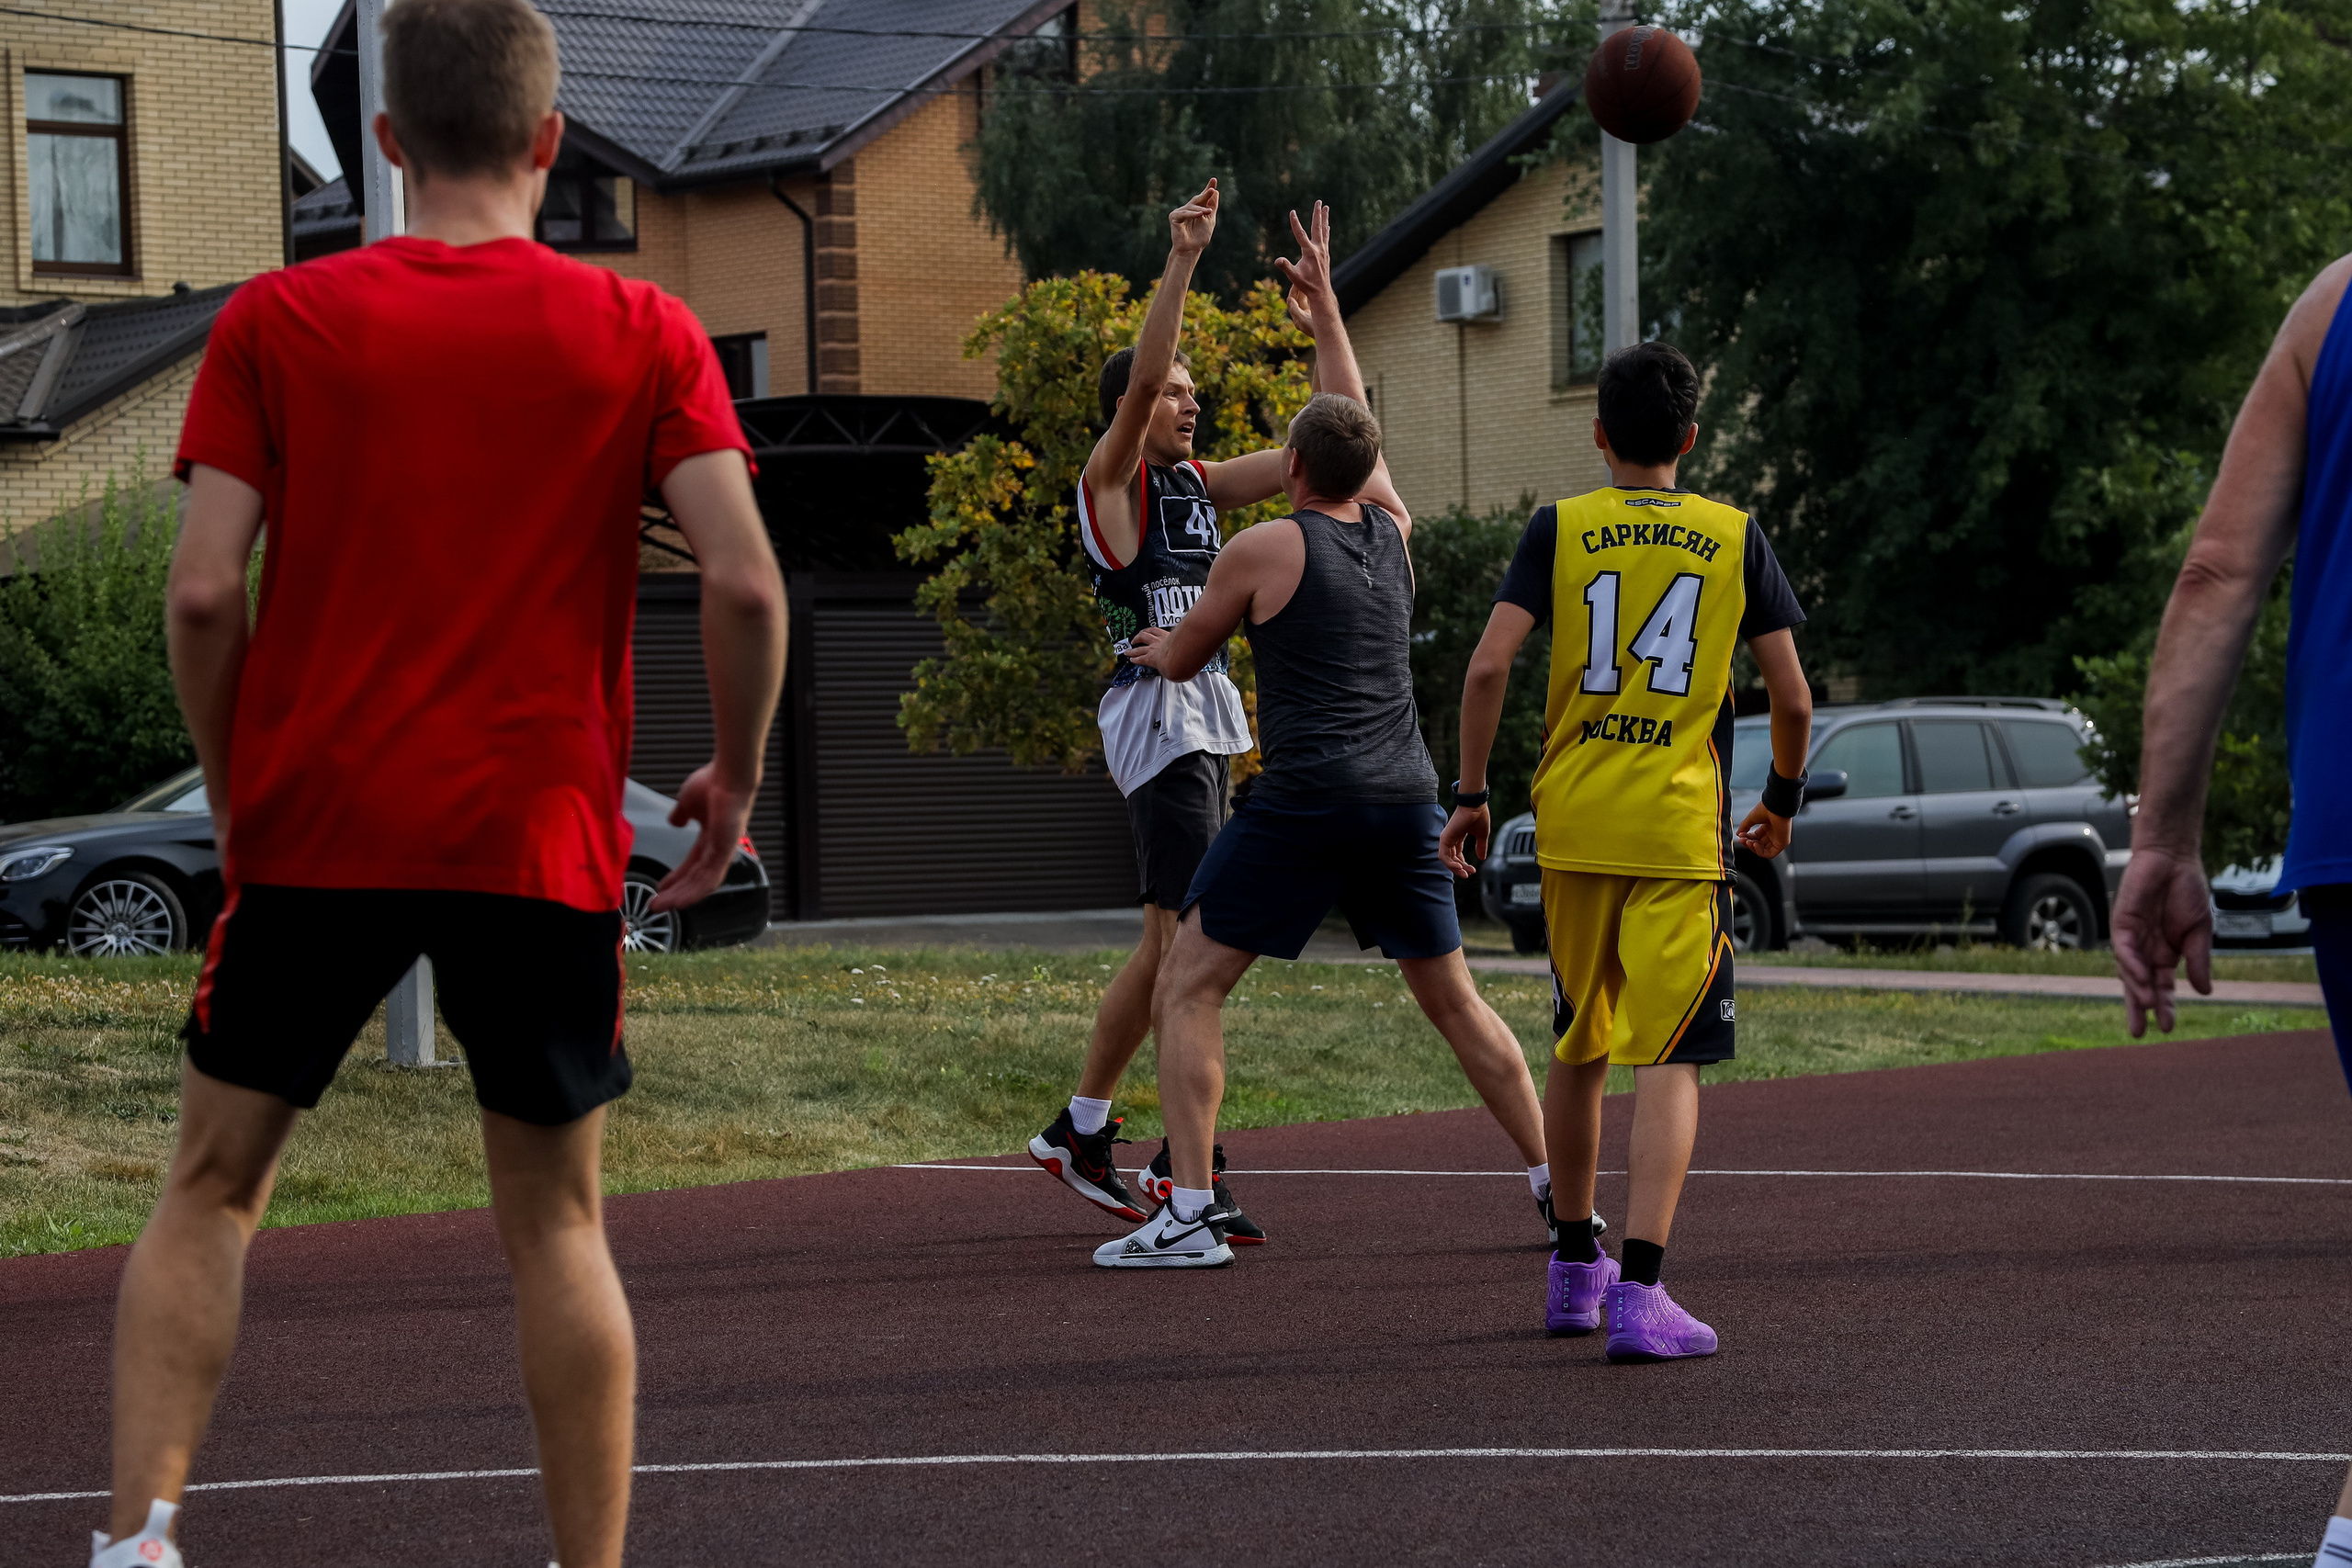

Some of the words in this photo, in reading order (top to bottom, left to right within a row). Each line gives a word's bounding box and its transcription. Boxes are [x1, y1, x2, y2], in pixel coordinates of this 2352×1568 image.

[1581, 523, 1721, 562] САРКИСЯН
[1150, 576, 1180, 590] посёлок
[1579, 570, 1704, 697] 14
